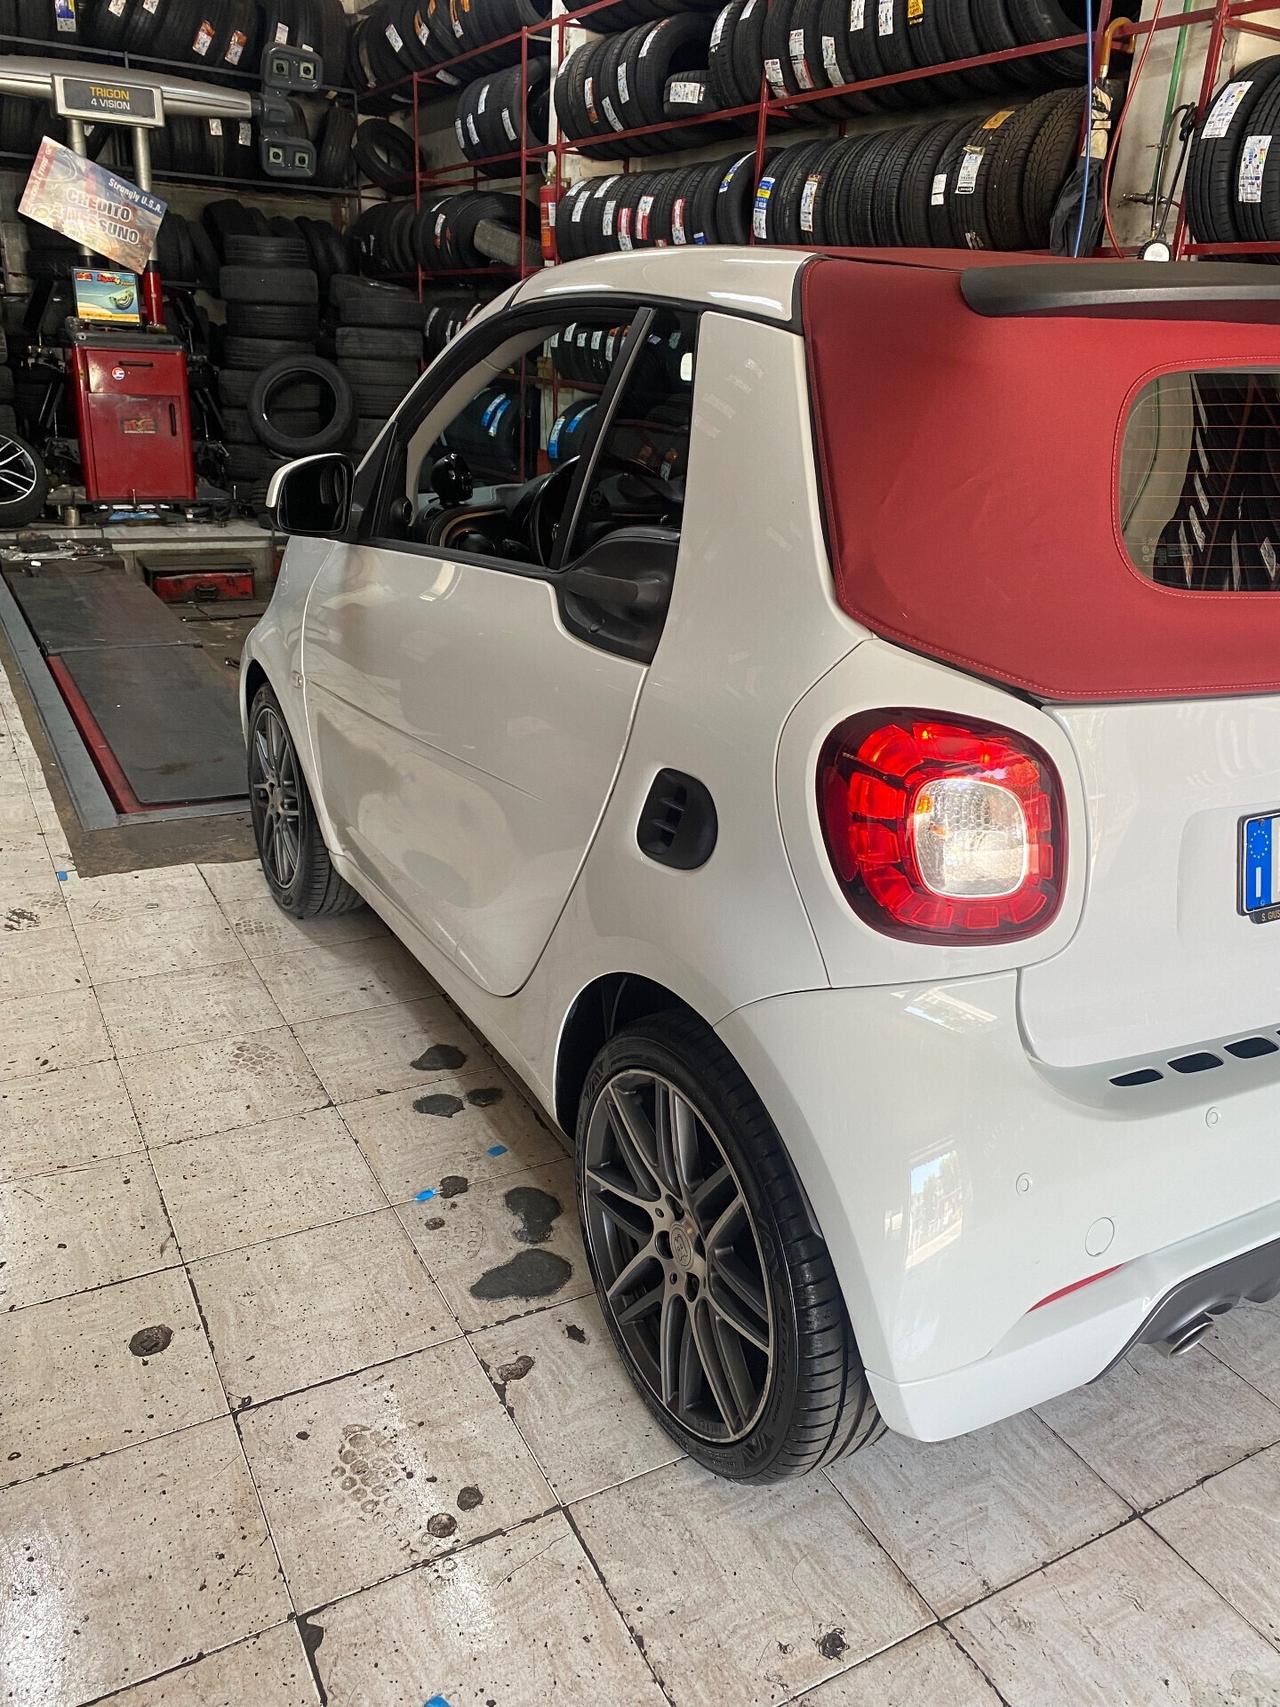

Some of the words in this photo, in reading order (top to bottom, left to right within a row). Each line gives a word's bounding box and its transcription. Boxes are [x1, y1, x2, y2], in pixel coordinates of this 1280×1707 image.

[89, 86, 129, 100] TRIGON
[91, 97, 97, 106] 4
[99, 98, 130, 110] VISION
[66, 188, 132, 223] CREDITO
[108, 178, 140, 203] Strongly
[140, 195, 163, 214] U.S.A.
